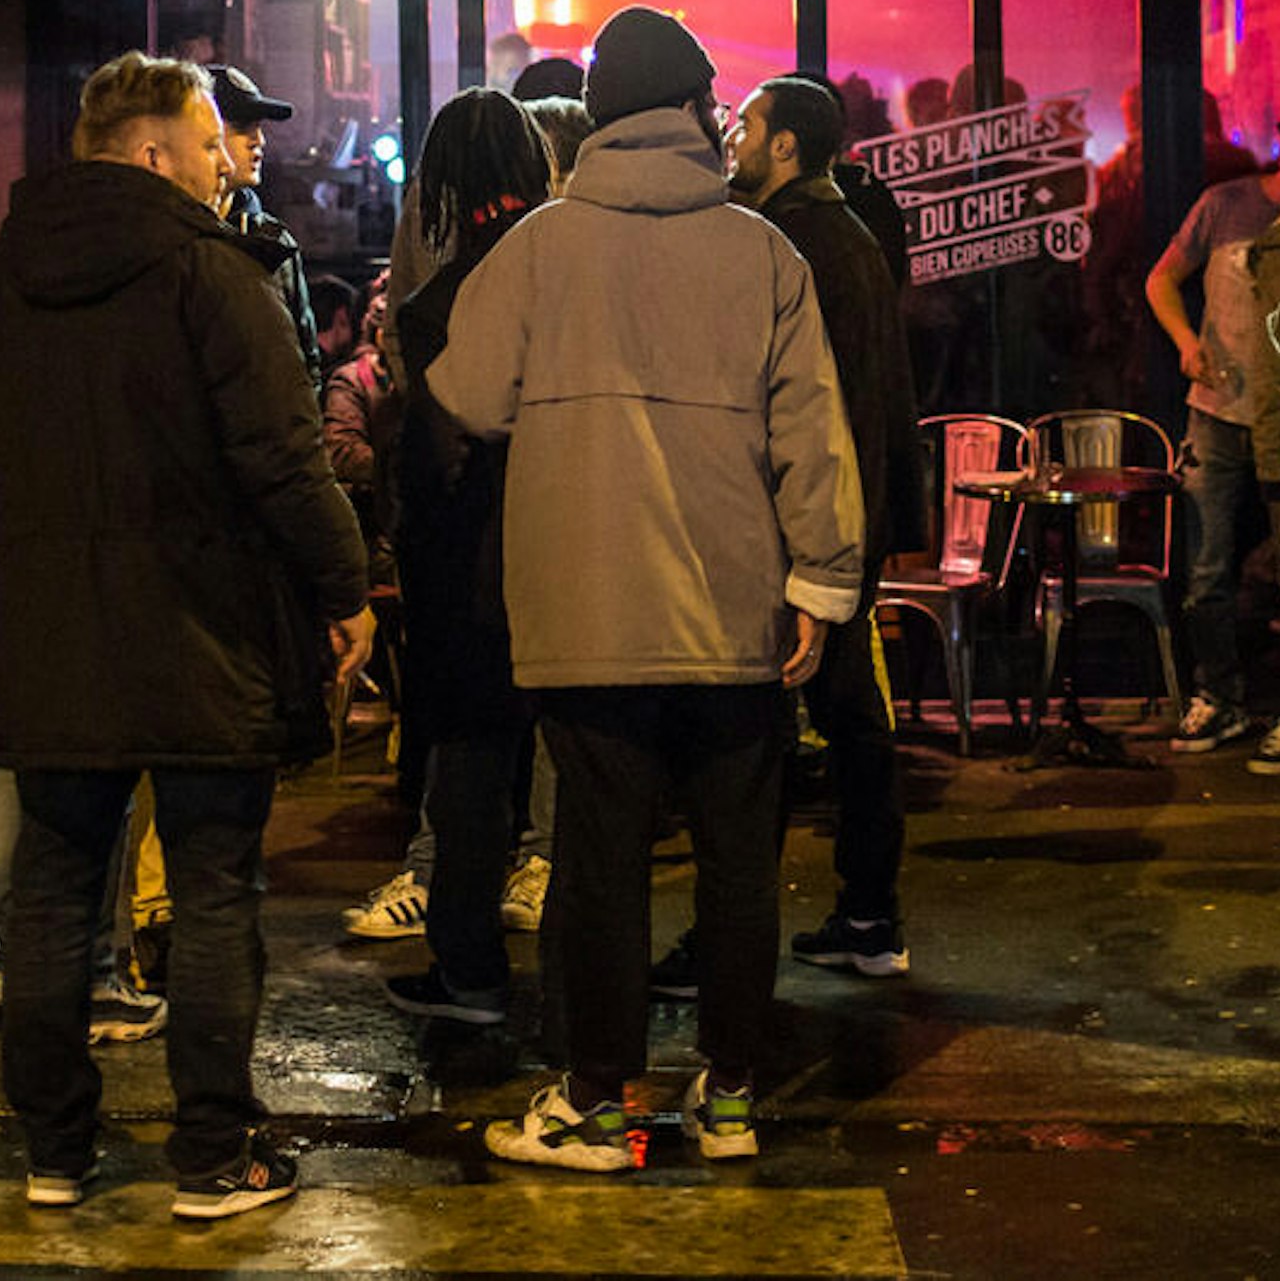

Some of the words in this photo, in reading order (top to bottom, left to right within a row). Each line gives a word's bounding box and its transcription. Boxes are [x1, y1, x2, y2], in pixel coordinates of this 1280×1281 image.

[871, 134, 921, 181] LES
[925, 107, 1060, 170] PLANCHES
[919, 200, 957, 241] DU
[961, 183, 1028, 230] CHEF
[909, 249, 949, 277] BIEN
[951, 226, 1041, 268] COPIEUSES
